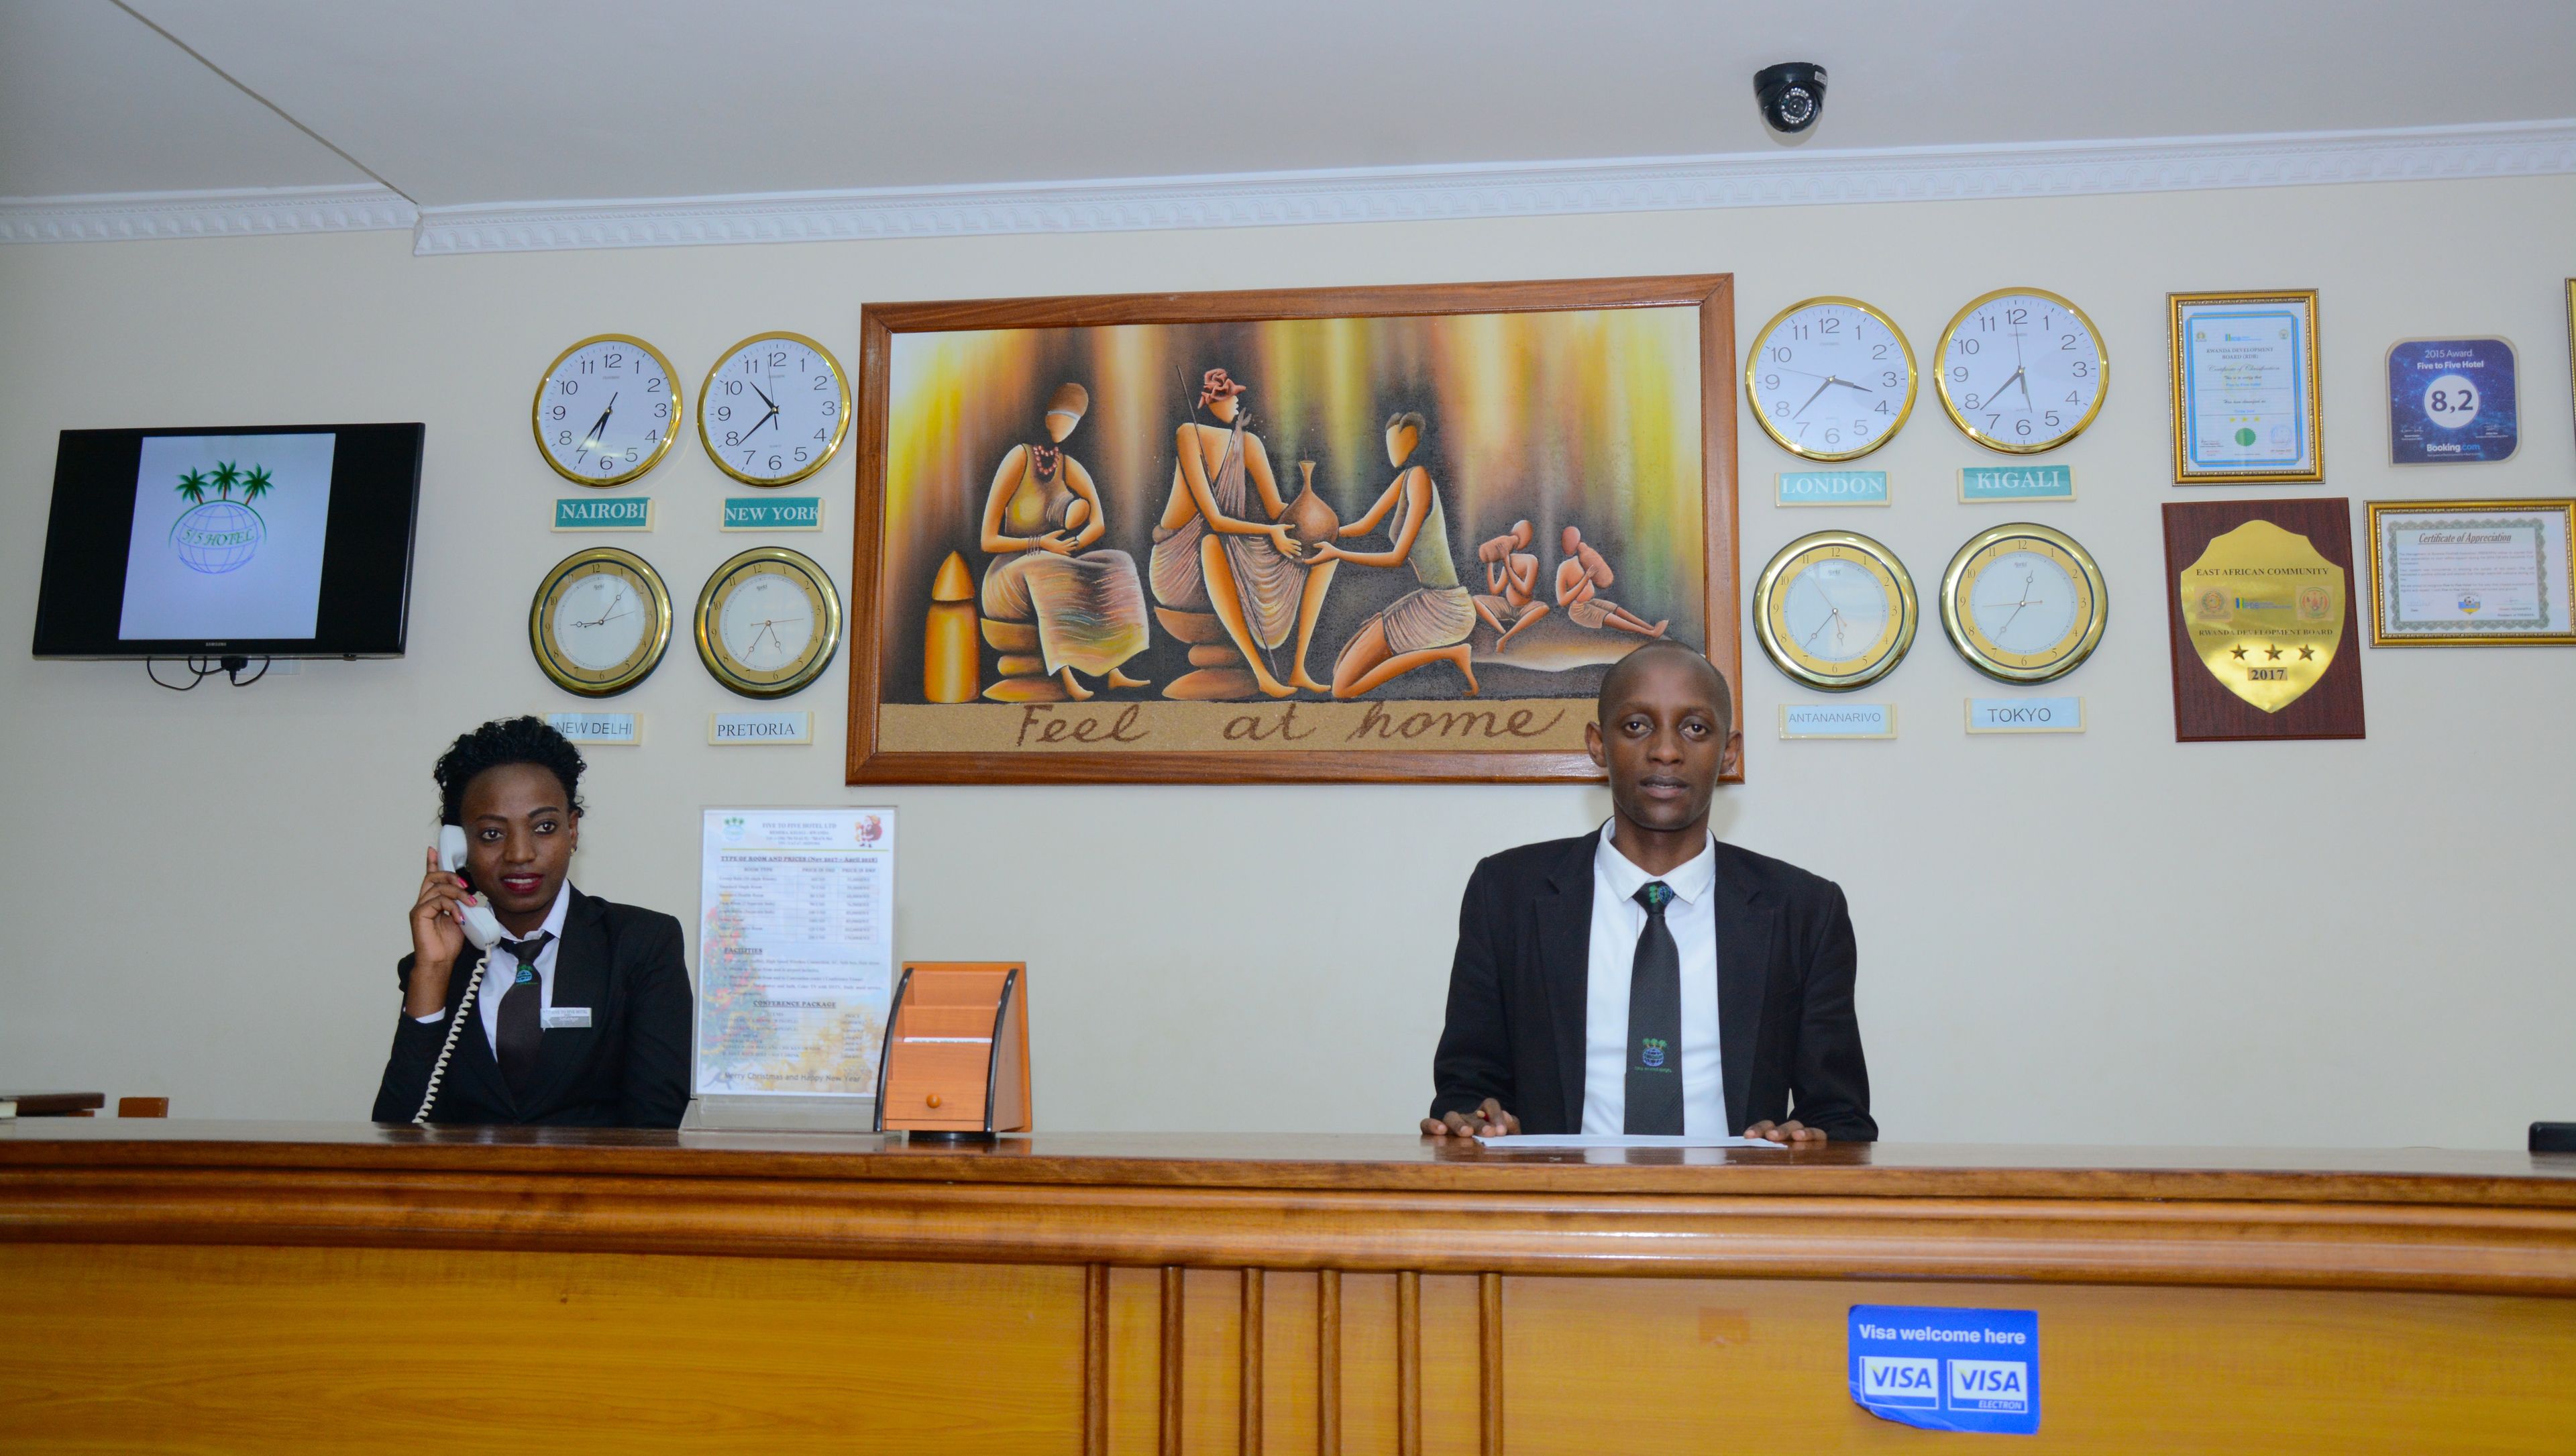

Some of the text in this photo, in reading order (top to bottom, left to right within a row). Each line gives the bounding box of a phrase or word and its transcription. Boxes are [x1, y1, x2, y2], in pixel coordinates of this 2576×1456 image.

[1980, 316, 1995, 331] 11
[2006, 309, 2027, 325] 12
[2044, 315, 2049, 330] 1
[1793, 325, 1807, 340] 11
[1819, 318, 1839, 333] 12
[1856, 325, 1860, 340] 1
[1959, 339, 1980, 354] 10
[2061, 335, 2077, 350] 2
[768, 352, 786, 367] 12
[1772, 347, 1792, 362] 10
[1872, 344, 1887, 360] 2
[2425, 349, 2472, 358] 2015 Award
[581, 360, 594, 374] 11
[604, 354, 622, 368] 12
[635, 360, 639, 374] 1
[745, 359, 757, 374] 11
[800, 358, 804, 372] 1
[1953, 366, 1968, 382] 9
[2072, 362, 2088, 377] 3
[647, 378, 661, 393] 2
[814, 376, 827, 391] 2
[1765, 374, 1780, 390] 9
[1882, 372, 1897, 387] 3
[561, 380, 578, 395] 10
[724, 380, 742, 395] 10
[1965, 393, 1980, 409] 8
[2065, 391, 2080, 405] 4
[2431, 389, 2473, 413] 8,2
[553, 405, 566, 420] 9
[654, 403, 667, 417] 3
[718, 406, 731, 421] 9
[822, 401, 835, 416] 3
[1775, 401, 1790, 417] 8
[1874, 400, 1889, 415] 4
[1986, 414, 2000, 429] 7
[2045, 411, 2059, 426] 5
[1796, 421, 1810, 437] 7
[1854, 420, 1868, 435] 5
[2016, 419, 2031, 435] 6
[559, 430, 572, 446] 8
[645, 429, 657, 444] 4
[725, 431, 739, 446] 8
[814, 428, 826, 442] 4
[1825, 428, 1840, 444] 6
[625, 448, 637, 462] 5
[794, 447, 807, 462] 5
[2427, 443, 2480, 452] Booking.com
[576, 450, 588, 464] 7
[600, 456, 612, 470] 6
[743, 450, 756, 465] 7
[768, 455, 782, 470] 6
[1782, 477, 1883, 495] LONDON
[1976, 471, 2060, 489] KIGALI
[561, 504, 645, 519] NAIROBI
[725, 507, 817, 521] NEW YORK
[182, 529, 254, 546] 5/5 HOTEL
[2419, 532, 2512, 543] Certificate of Appreciation
[2251, 670, 2284, 680] 2017
[1788, 712, 1881, 723] ANTANANARIVO
[1987, 708, 2051, 723] TOKYO
[555, 723, 632, 735] NEW DELHI
[717, 723, 795, 737] PRETORIA
[1016, 701, 1565, 747] Feel at home
[801, 1074, 823, 1082] Happy
[1859, 1324, 2026, 1345] Visa welcome here
[1870, 1365, 1932, 1389] VISA
[1957, 1369, 2021, 1392] VISA
[1978, 1400, 2022, 1409] ELECTRON
